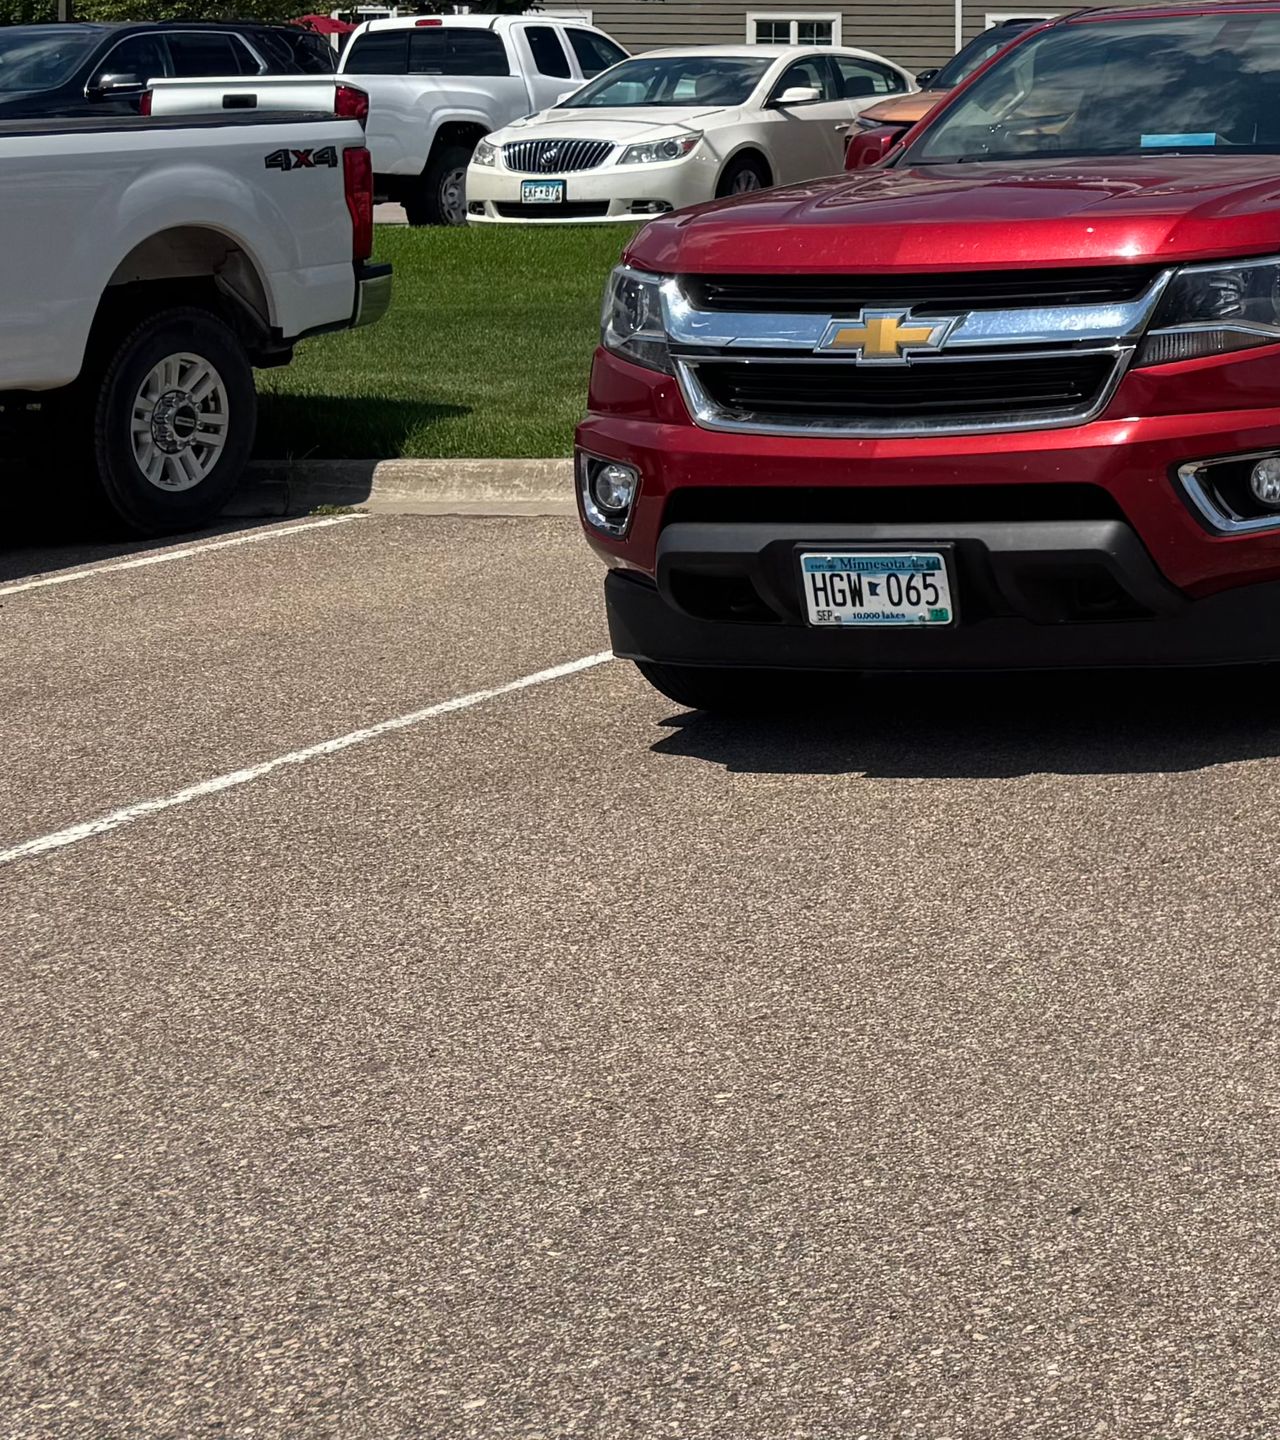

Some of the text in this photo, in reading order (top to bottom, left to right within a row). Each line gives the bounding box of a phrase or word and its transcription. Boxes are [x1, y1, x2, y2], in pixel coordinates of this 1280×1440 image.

[839, 557, 905, 570] Minnesota
[811, 572, 940, 608] HGW 065
[816, 610, 833, 622] SEP
[852, 610, 906, 620] 10,000 lakes
